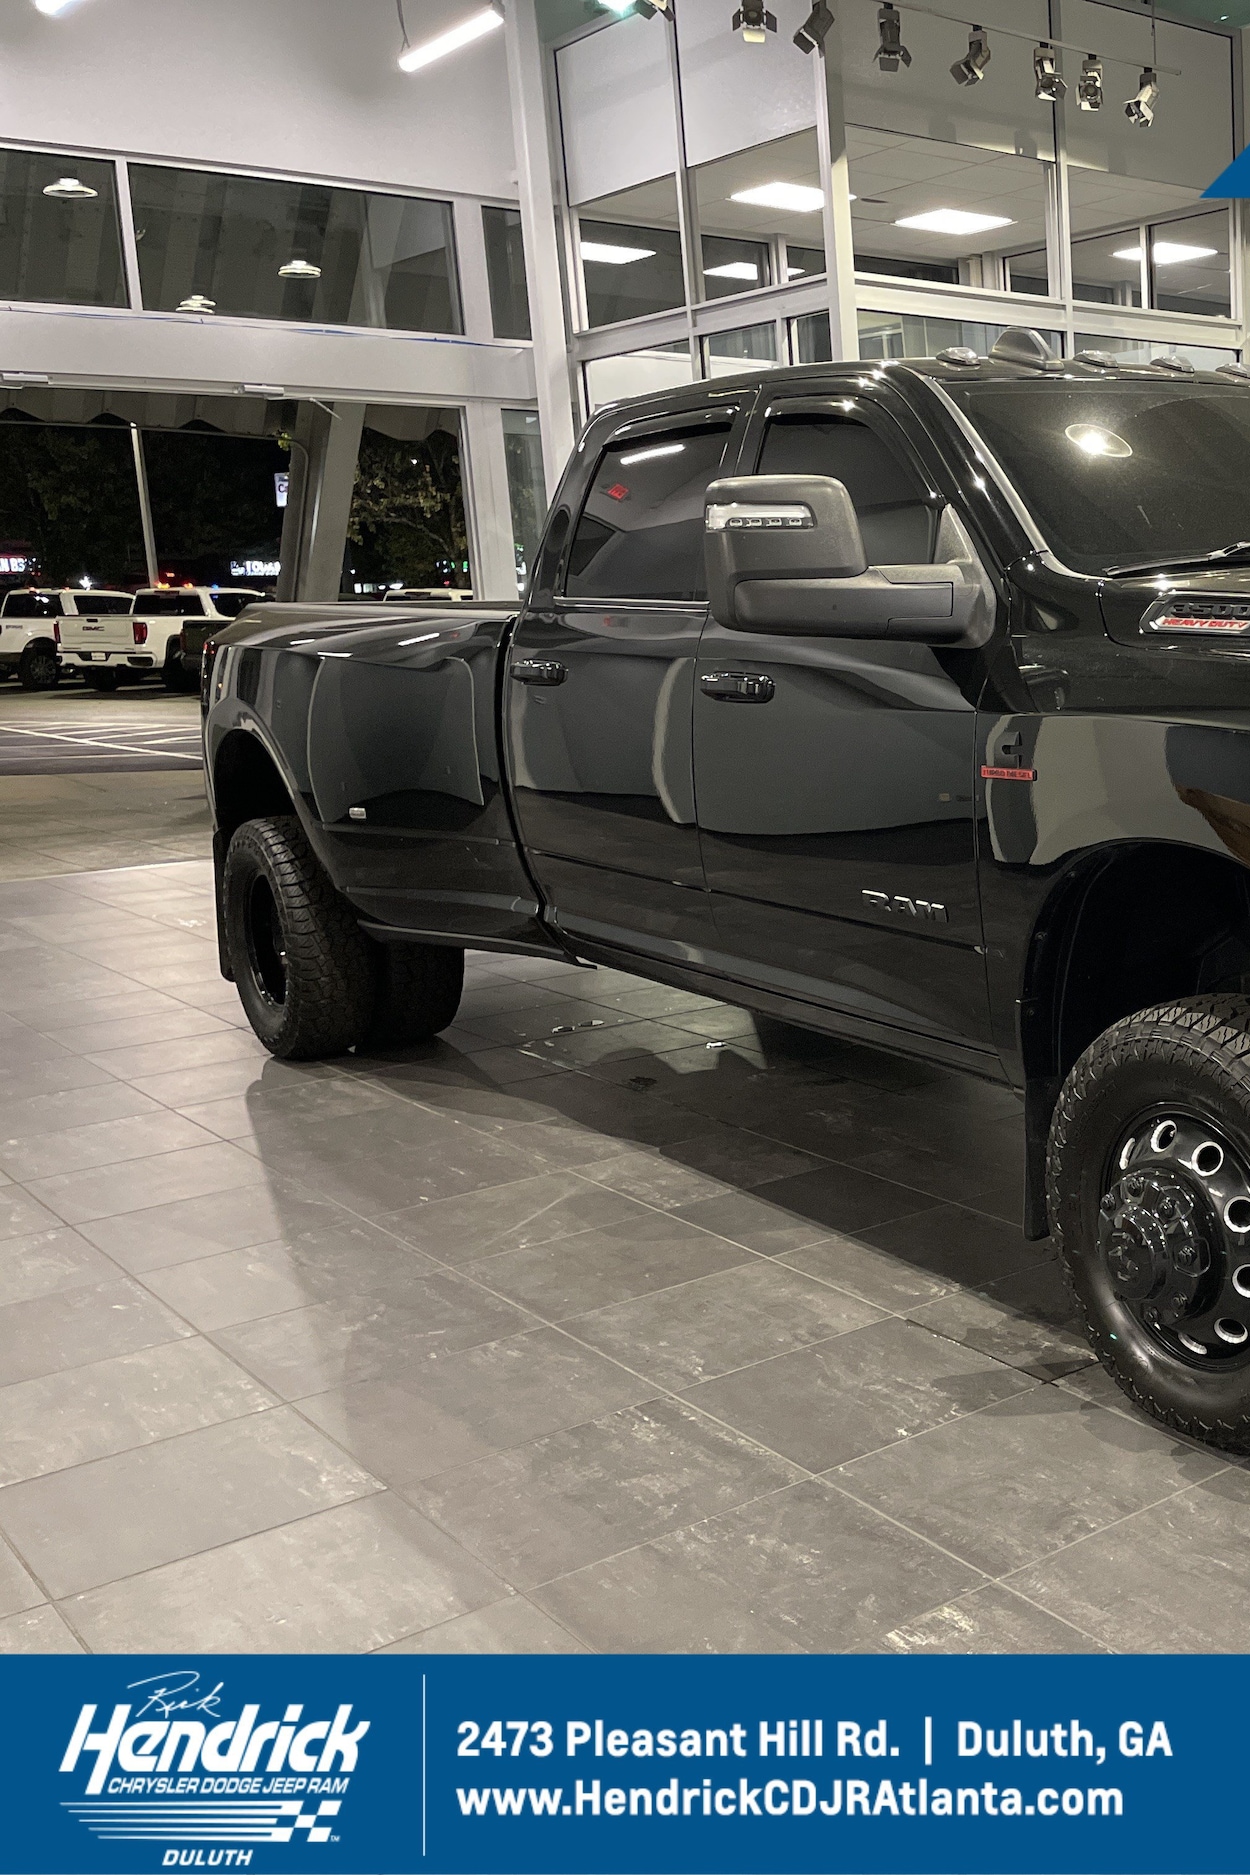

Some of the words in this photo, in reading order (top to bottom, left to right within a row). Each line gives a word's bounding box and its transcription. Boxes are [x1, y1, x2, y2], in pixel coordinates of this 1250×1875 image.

[1162, 618, 1209, 627] HEAVY
[1208, 621, 1248, 629] DUTY
[861, 889, 949, 923] RAM
